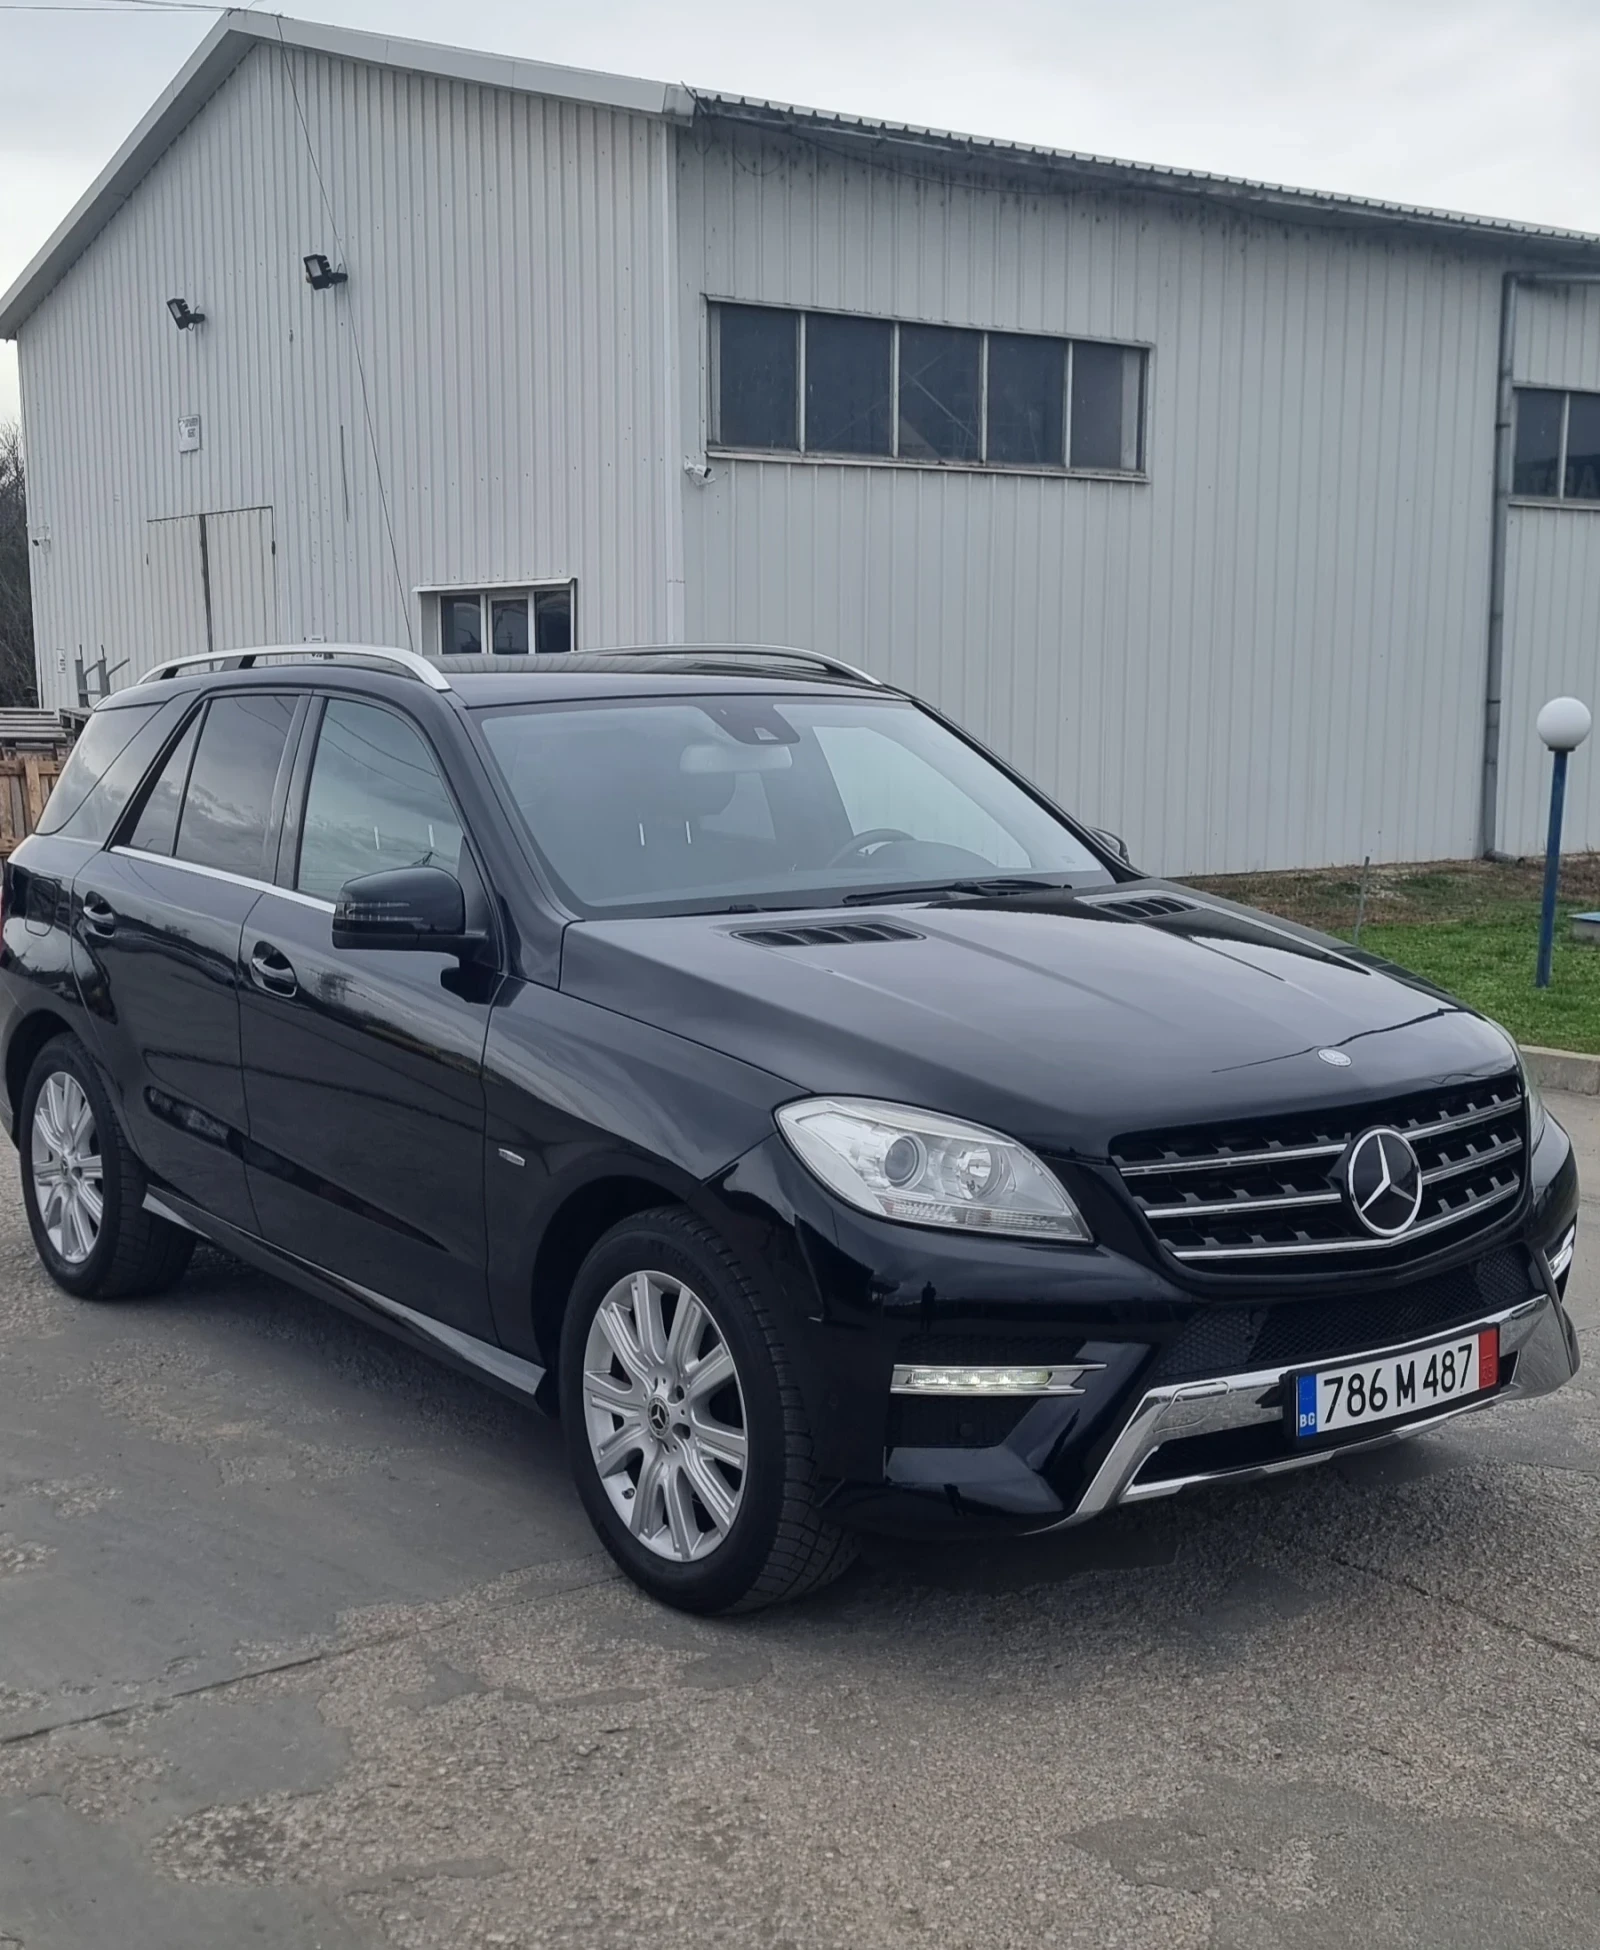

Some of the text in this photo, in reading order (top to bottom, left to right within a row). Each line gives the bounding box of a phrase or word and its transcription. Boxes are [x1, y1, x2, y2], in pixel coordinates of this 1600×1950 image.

[1323, 1343, 1473, 1424] 786 M 487
[1299, 1412, 1316, 1428] BG
